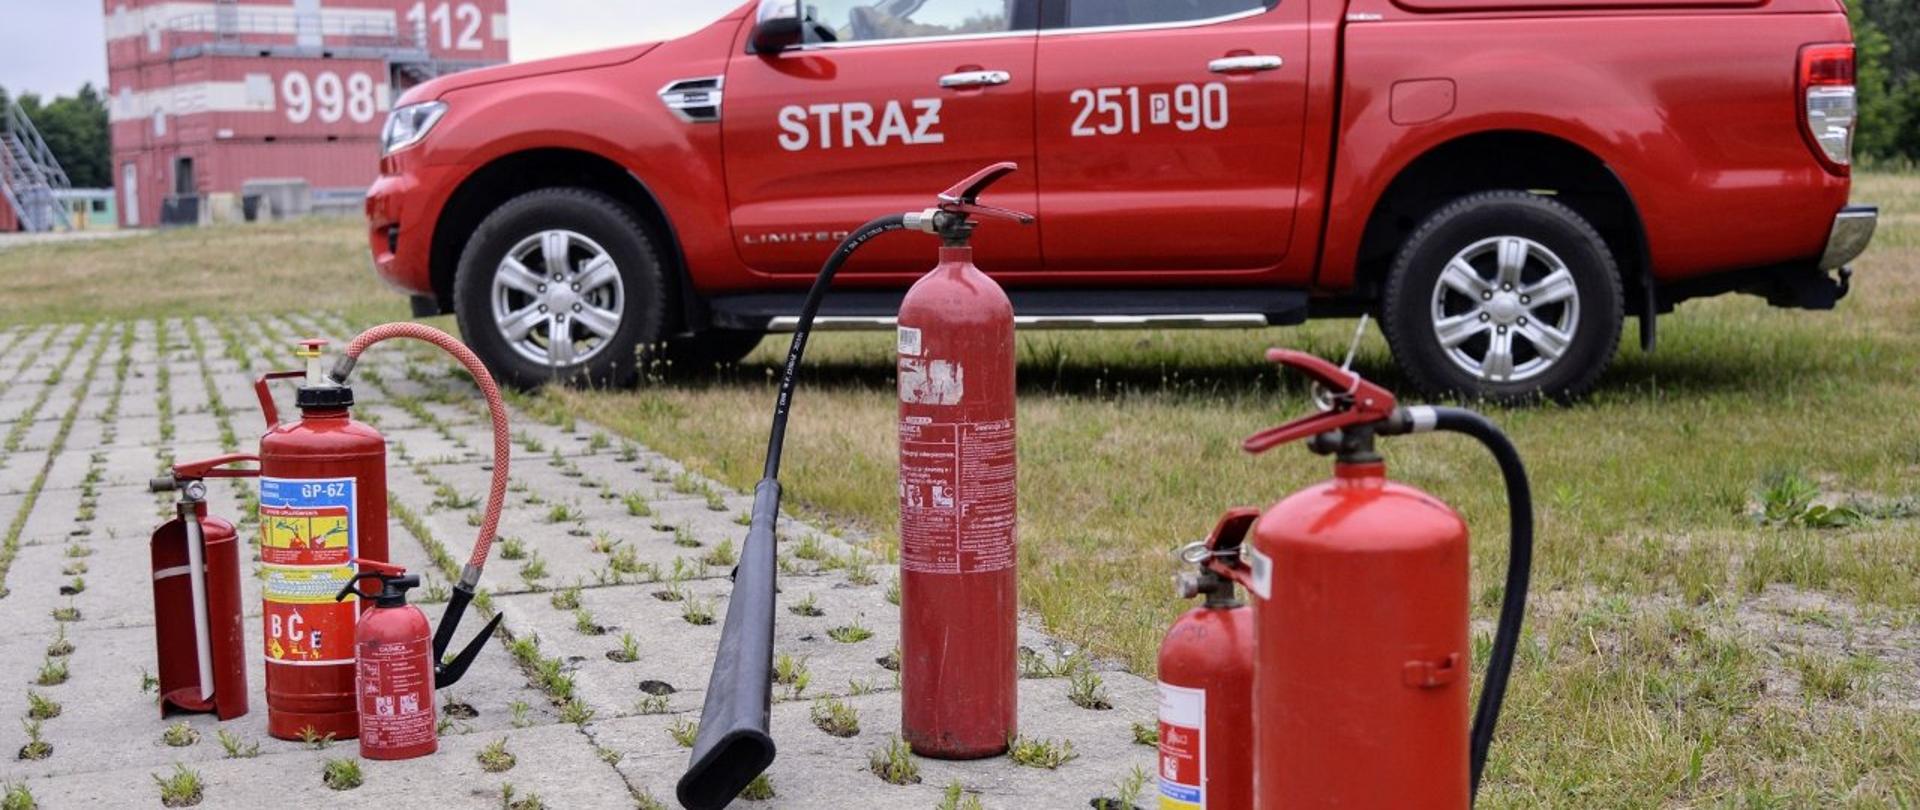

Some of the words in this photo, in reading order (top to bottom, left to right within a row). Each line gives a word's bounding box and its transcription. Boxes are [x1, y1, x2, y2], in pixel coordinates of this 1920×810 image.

[406, 1, 484, 50] 112
[282, 71, 376, 123] 998
[1070, 86, 1141, 136] 251
[1174, 82, 1229, 131] 90
[743, 230, 850, 244] LIMITED
[302, 483, 345, 498] GP-6Z
[271, 614, 282, 638] B
[288, 612, 304, 641] C
[311, 631, 321, 648] E
